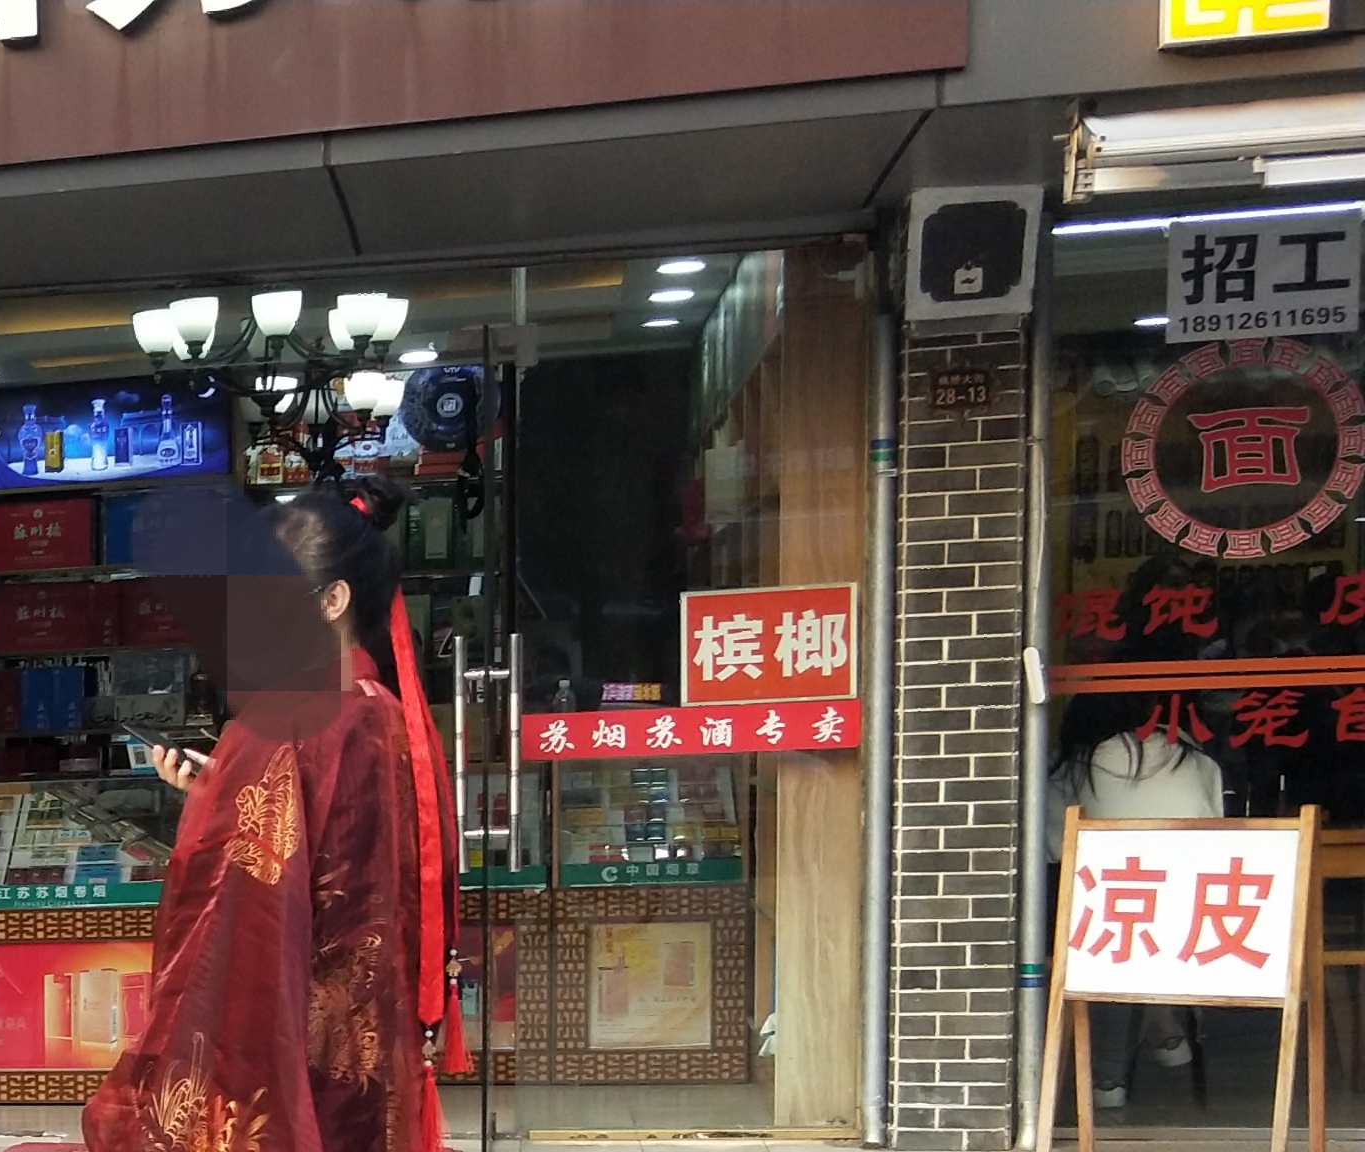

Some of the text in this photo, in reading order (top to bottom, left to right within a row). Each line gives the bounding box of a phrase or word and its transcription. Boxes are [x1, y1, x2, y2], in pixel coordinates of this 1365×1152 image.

[1180, 230, 1350, 305] 招工
[1178, 305, 1347, 335] 18912611695
[936, 386, 987, 406] 28-13
[1188, 406, 1310, 493] 面
[693, 609, 848, 682] 槟榔
[539, 706, 846, 754] 苏烟苏酒专卖
[626, 862, 701, 878] 中国烟草
[1069, 856, 1275, 970] 凉皮
